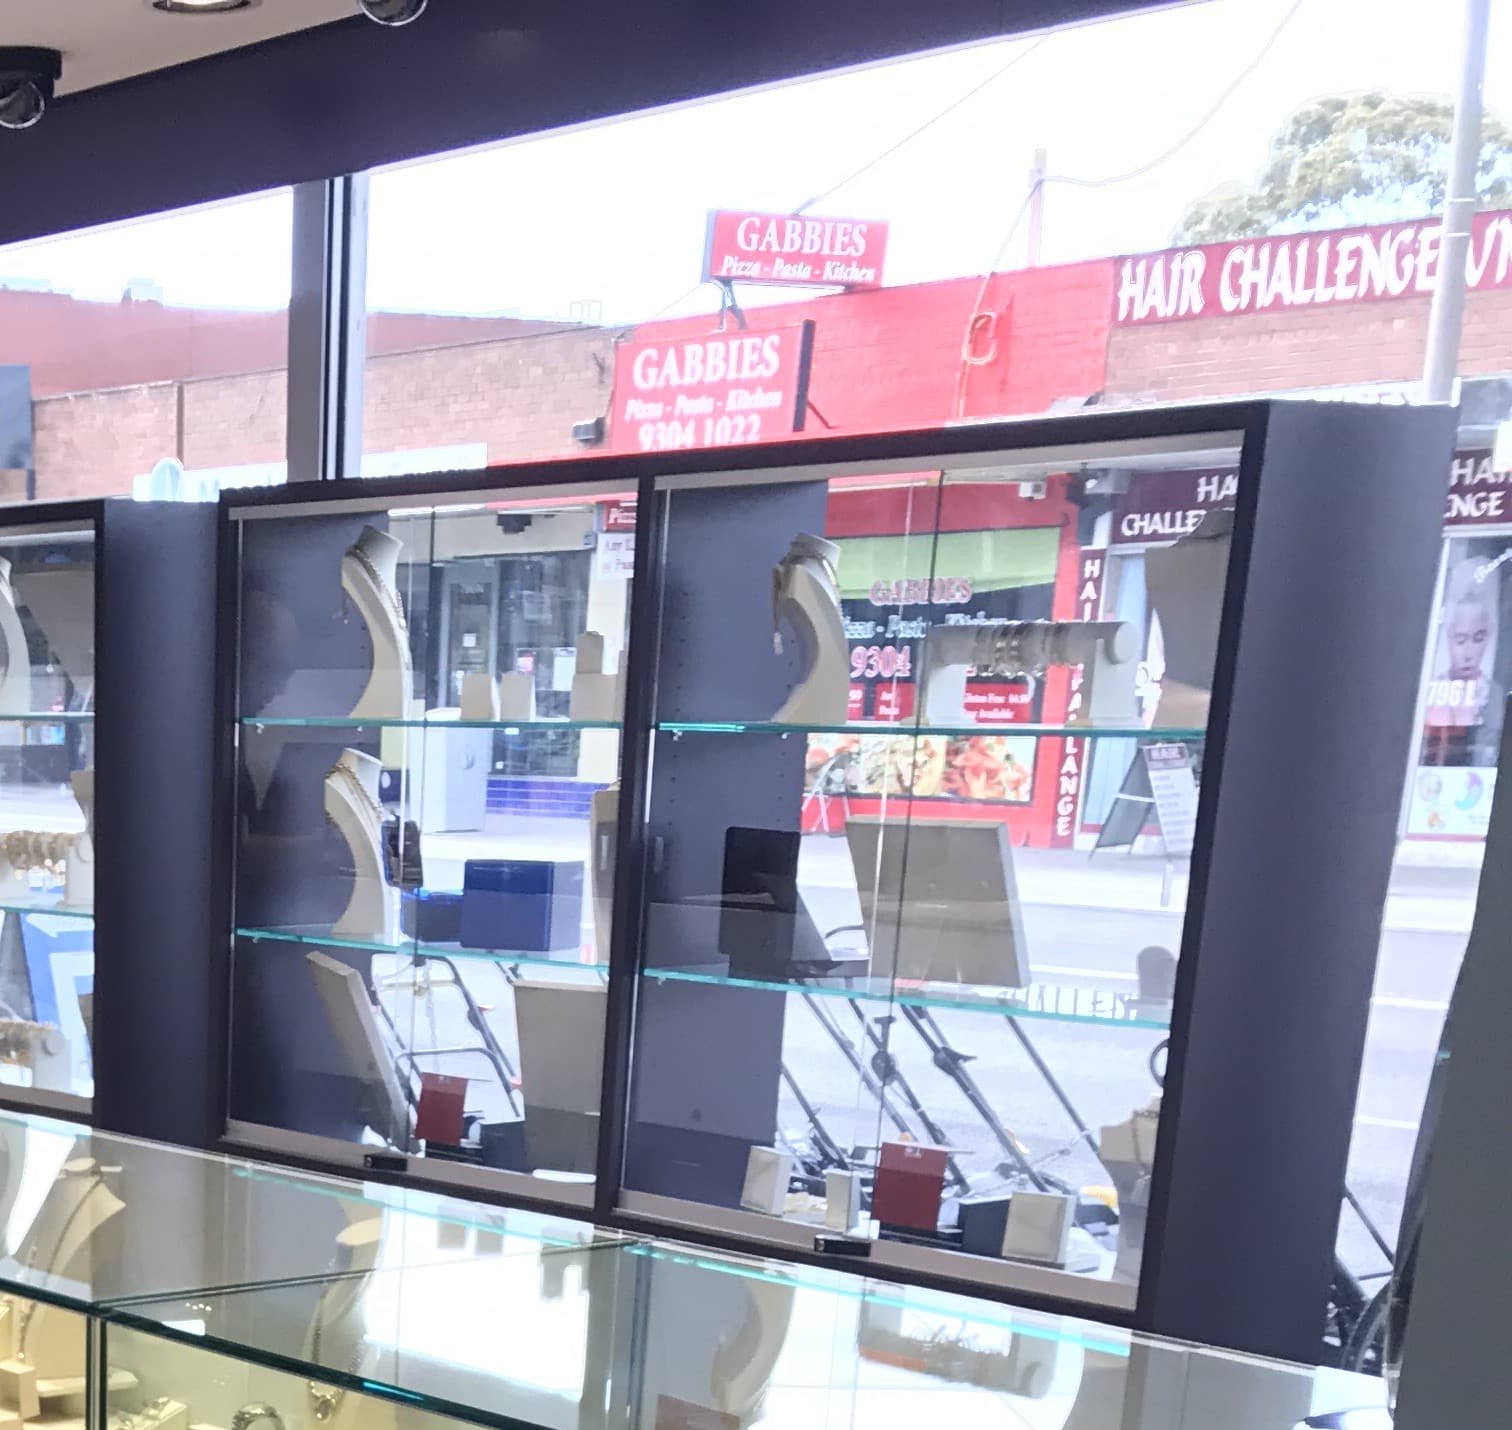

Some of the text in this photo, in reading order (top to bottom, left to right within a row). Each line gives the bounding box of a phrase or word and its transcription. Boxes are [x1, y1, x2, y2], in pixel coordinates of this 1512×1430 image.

[737, 217, 867, 257] GABBIES
[720, 255, 761, 276] Pizza
[772, 258, 811, 280] Pasta
[823, 260, 876, 282] Kitchen
[1118, 250, 1206, 322] HAIR
[1219, 225, 1443, 313] CHALLENGE
[633, 335, 780, 389] GABBIES
[639, 414, 761, 450] 9304 1022
[1121, 510, 1206, 537] CHALLE
[850, 645, 911, 678] 9304
